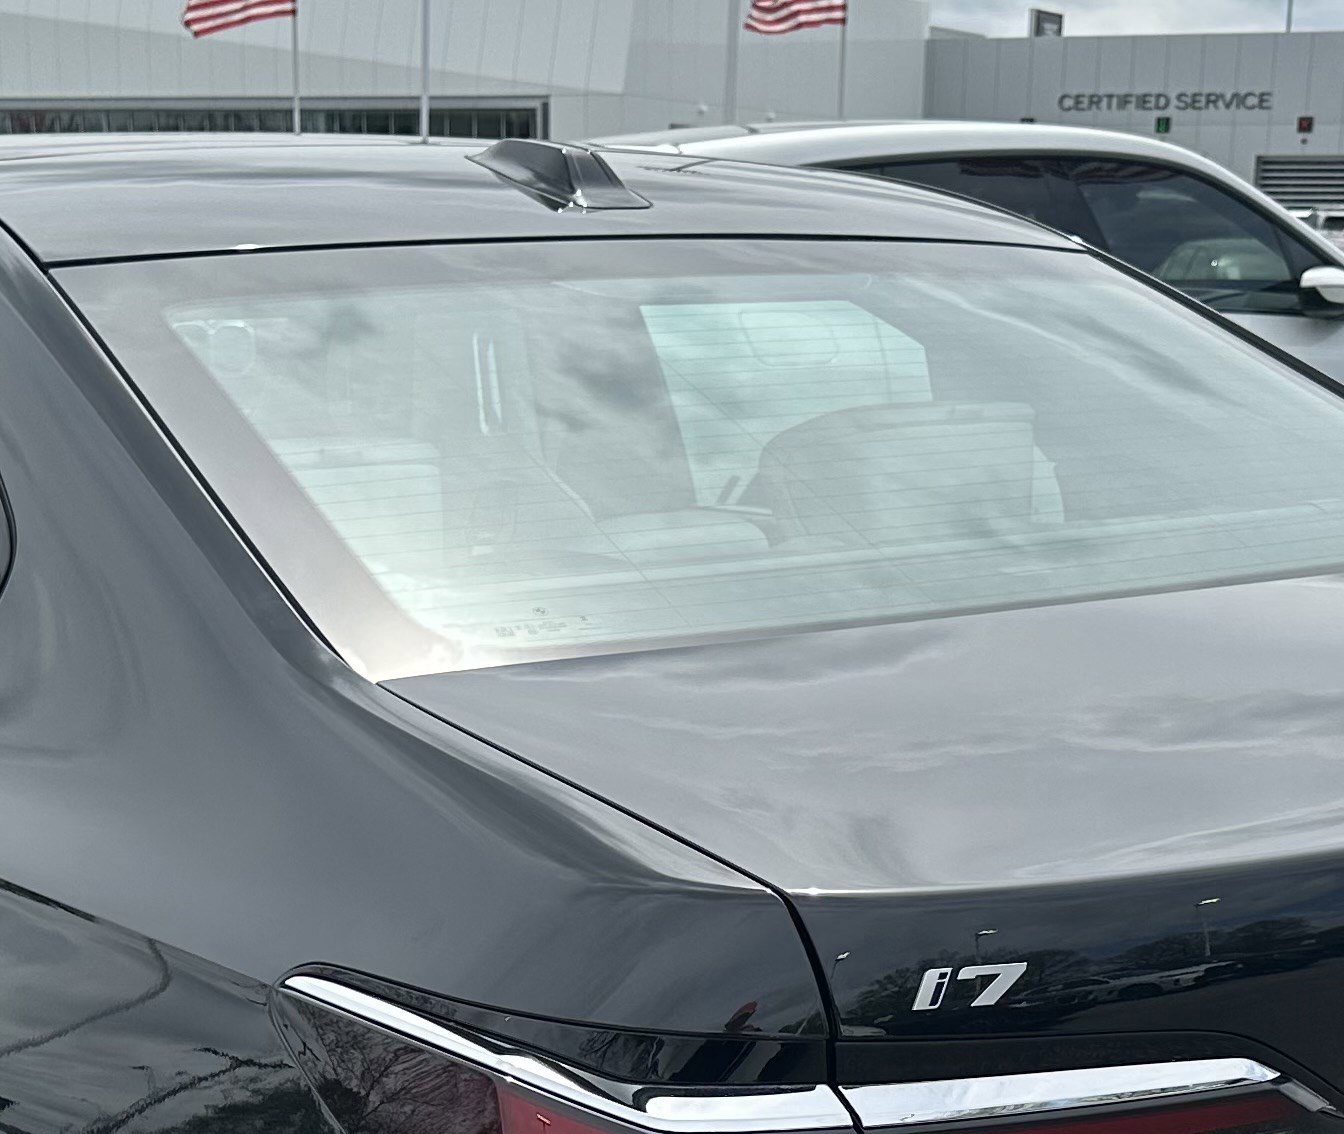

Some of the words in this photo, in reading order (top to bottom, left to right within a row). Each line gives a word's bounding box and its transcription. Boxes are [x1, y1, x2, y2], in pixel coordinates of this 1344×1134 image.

[1058, 93, 1170, 112] CERTIFIED
[1175, 91, 1273, 111] SERVICE
[912, 962, 1028, 1011] i7
